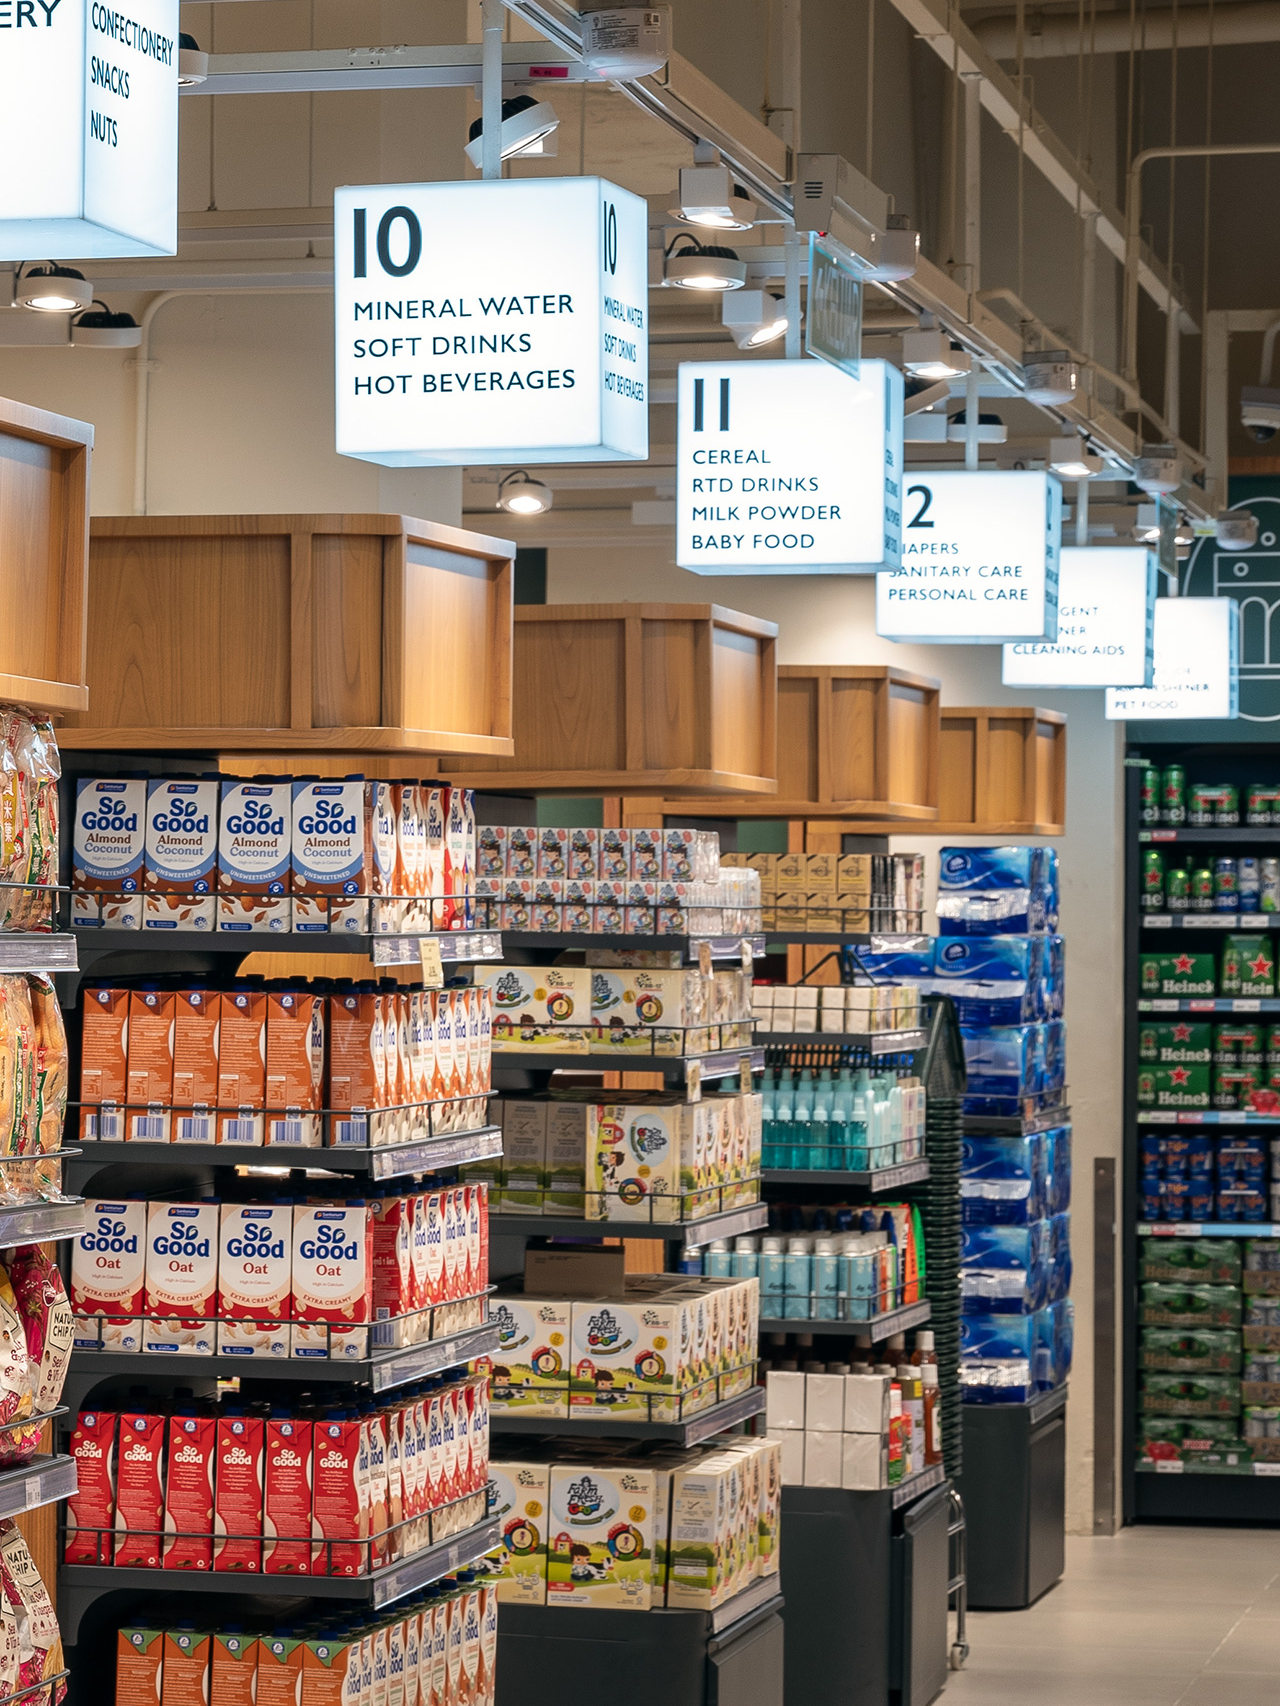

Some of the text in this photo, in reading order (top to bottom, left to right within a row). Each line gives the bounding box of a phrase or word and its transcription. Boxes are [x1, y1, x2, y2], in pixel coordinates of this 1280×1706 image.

[91, 2, 174, 67] CONFECTIONERY
[90, 56, 130, 100] SNACKS
[90, 110, 118, 148] NUTS
[354, 206, 422, 278] 10
[604, 201, 617, 275] 10
[354, 294, 573, 321] MINERAL WATER
[604, 296, 643, 329] MINERAL WATER
[354, 333, 531, 358] SOFT DRINKS
[604, 333, 636, 363] SOFT DRINKS
[354, 369, 575, 395] HOT BEVERAGES
[605, 371, 644, 403] HOT BEVERAGES
[694, 378, 730, 432] 11
[693, 450, 771, 464] CEREAL
[693, 477, 819, 493] RTD DRINKS
[692, 506, 841, 521] MILK POWDER
[907, 485, 934, 528] 2
[693, 534, 815, 549] BABY FOOD
[903, 543, 958, 555] IAPERS
[979, 565, 1023, 577] CARE
[889, 589, 1029, 600] PERSONAL CARE
[1013, 645, 1125, 655] CLEANING AIDS
[315, 800, 344, 818] So
[299, 816, 356, 834] Good
[305, 837, 350, 847] Almond
[303, 848, 352, 857] Coconut
[304, 870, 350, 880] UNSWEETENED
[317, 1225, 345, 1243] So
[300, 1240, 358, 1260] Good
[316, 1264, 341, 1276] Oat
[303, 1295, 352, 1306] EXTRA CREAMY
